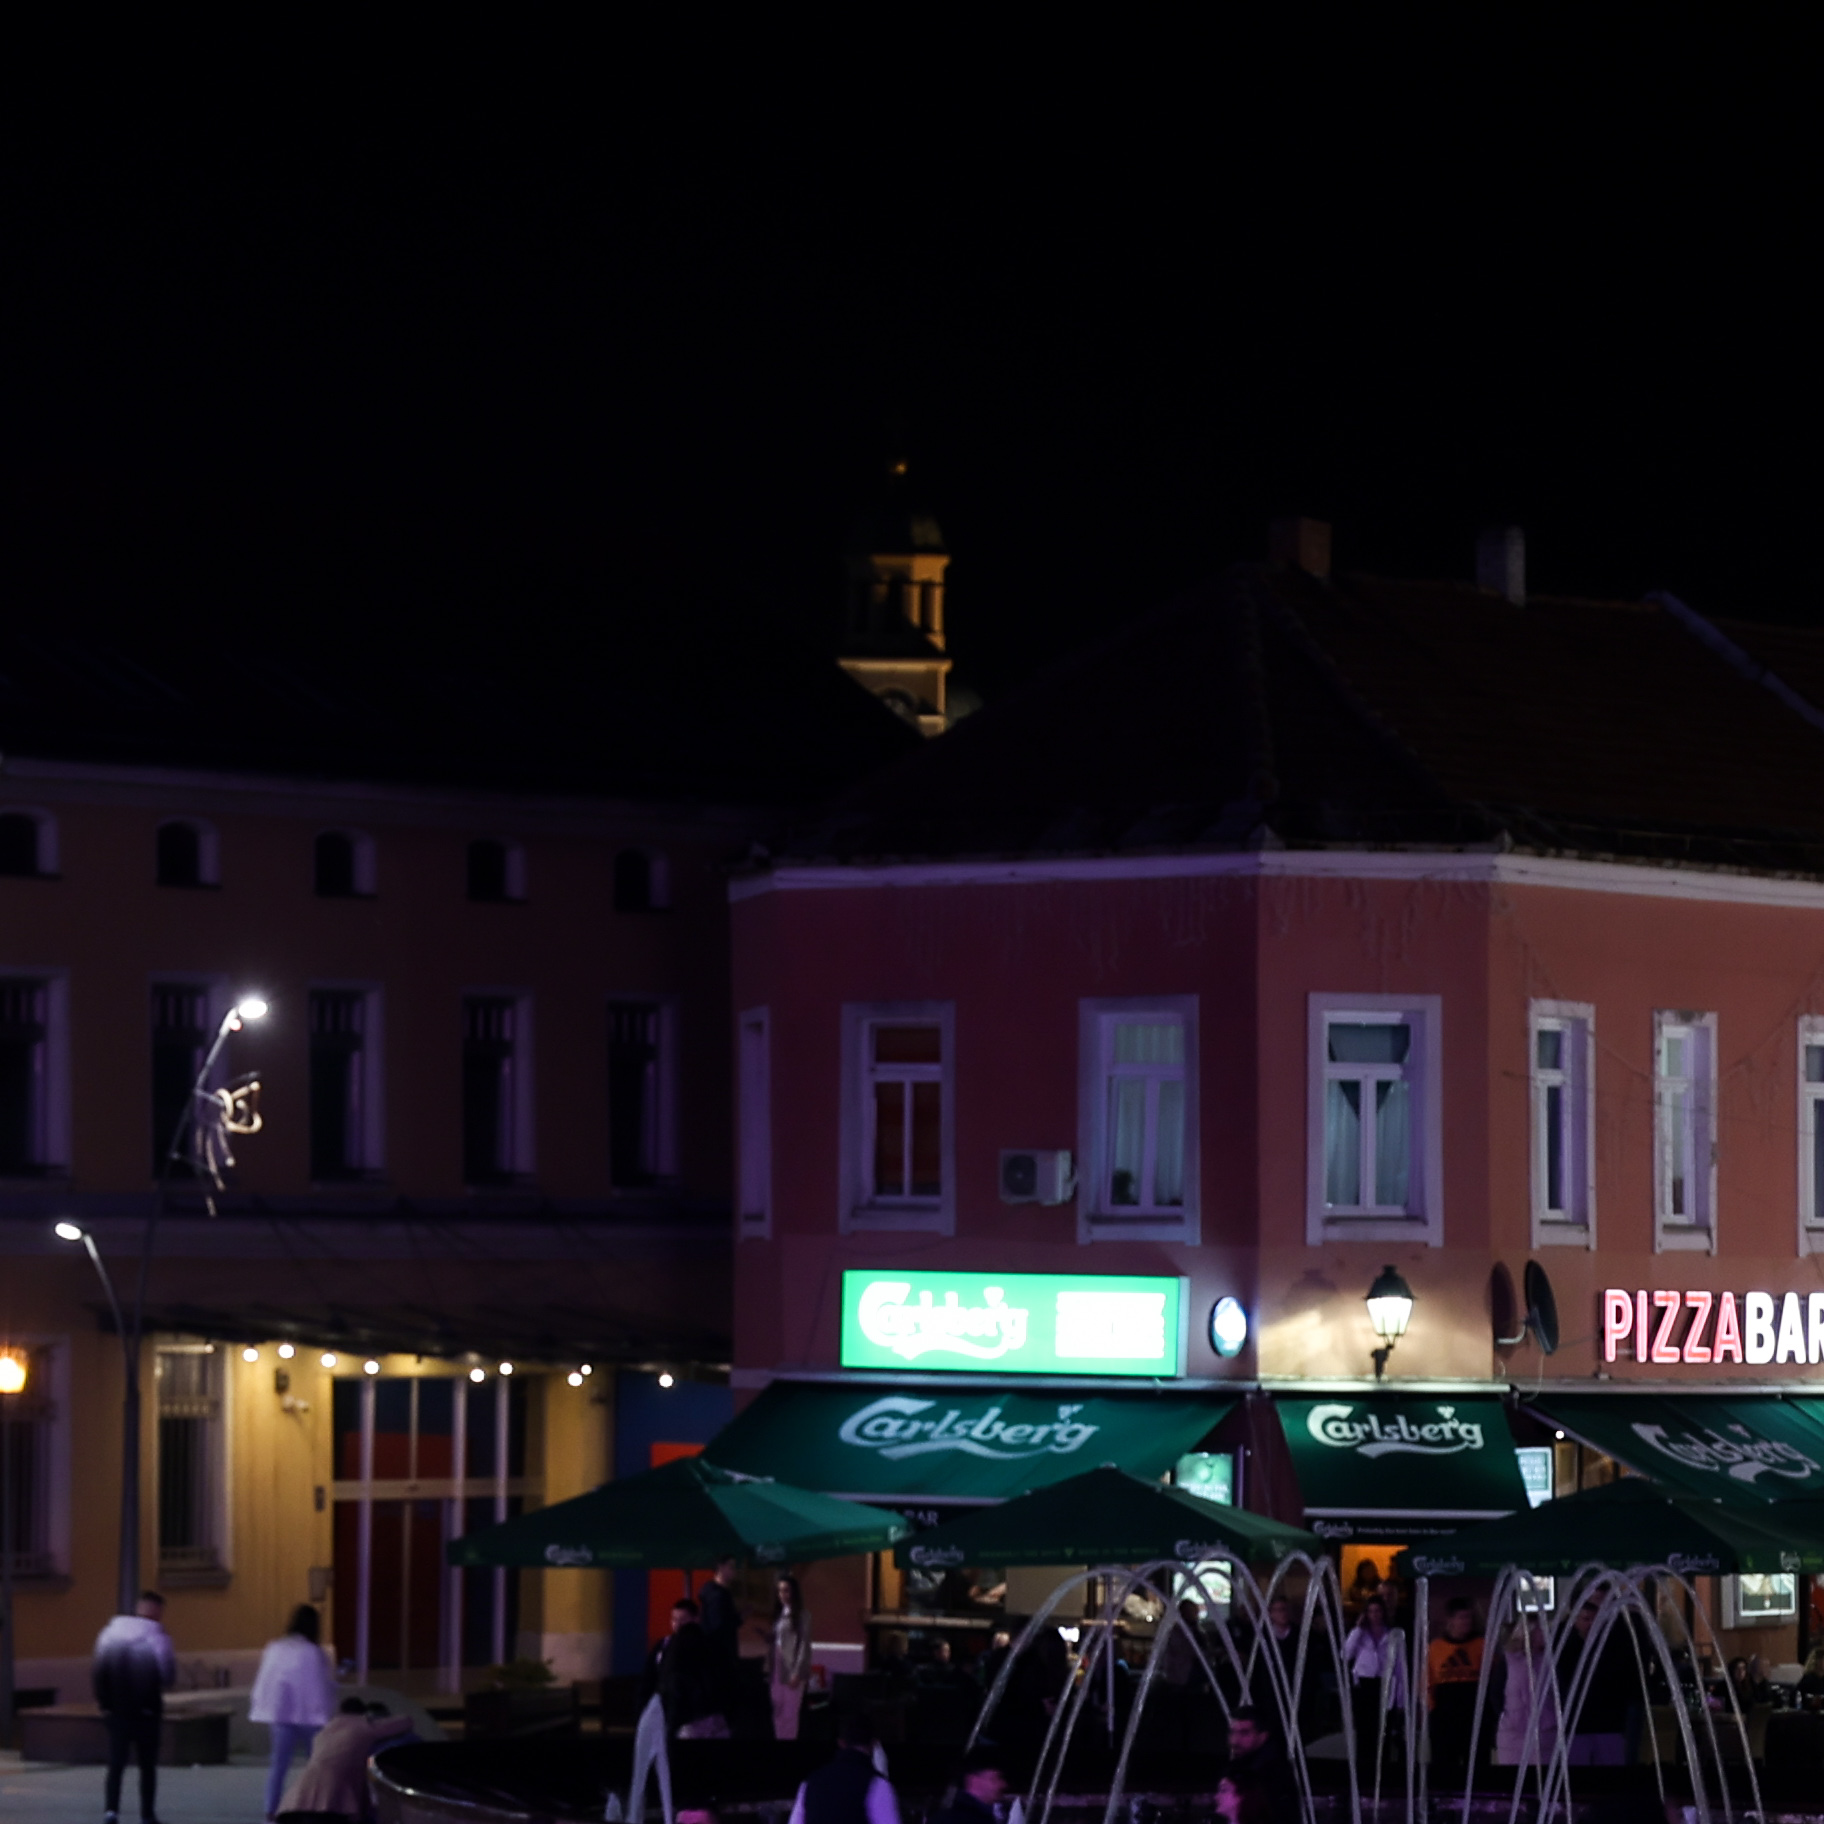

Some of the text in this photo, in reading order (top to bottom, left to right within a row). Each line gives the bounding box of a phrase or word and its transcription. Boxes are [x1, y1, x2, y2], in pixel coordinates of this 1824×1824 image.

[838, 1395, 1100, 1461] Carlsberg
[1306, 1403, 1483, 1456] Carlsberg
[1630, 1422, 1822, 1486] Carlsberg
